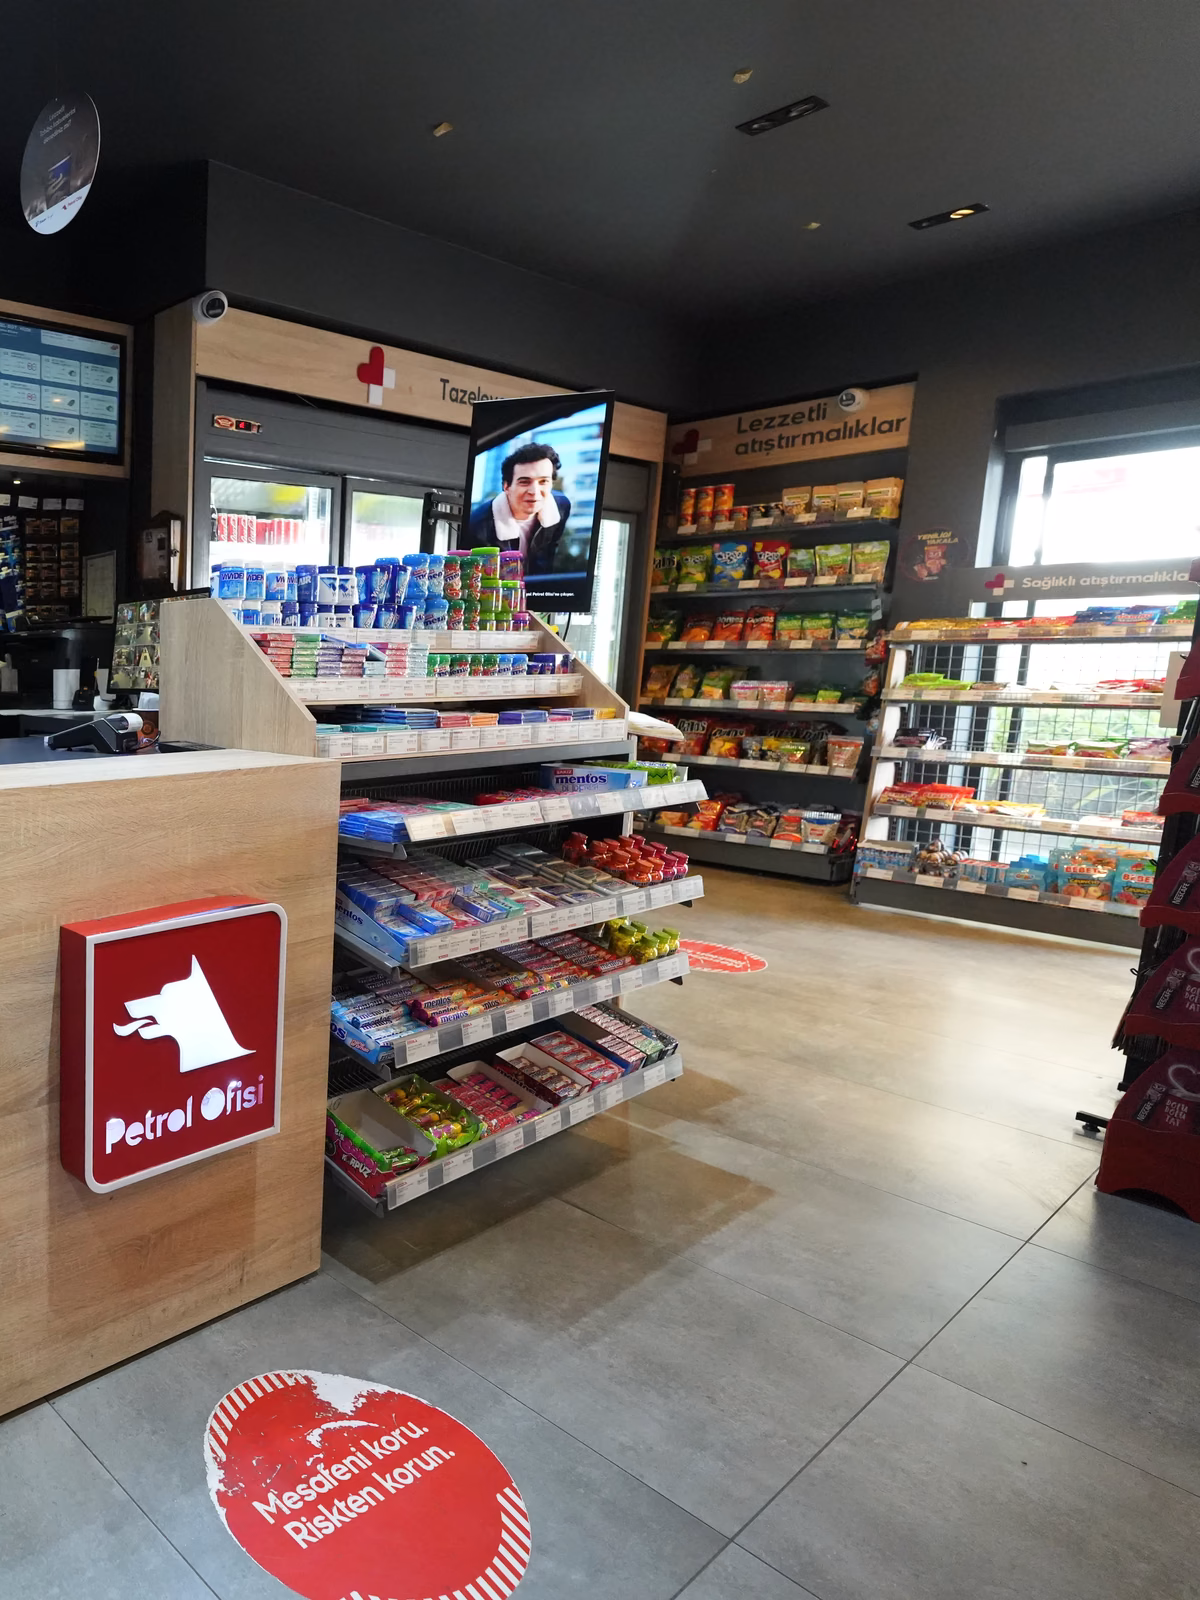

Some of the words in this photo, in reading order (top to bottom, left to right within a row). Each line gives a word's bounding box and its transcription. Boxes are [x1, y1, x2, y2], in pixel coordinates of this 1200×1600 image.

[737, 402, 828, 434] Lezzetli
[735, 416, 907, 456] atıştırmalıklar
[222, 572, 244, 580] VIVIDE
[1021, 576, 1076, 590] Sağlıklı
[555, 774, 607, 784] mentos
[423, 996, 451, 1009] mentos
[440, 1010, 469, 1024] mentos
[105, 1095, 193, 1154] Petrol
[200, 1074, 264, 1121] Ofisi
[252, 1439, 373, 1525] Mesafeni
[360, 1420, 429, 1460] koru.
[282, 1482, 385, 1549] Riskten
[371, 1443, 456, 1495] korun.
